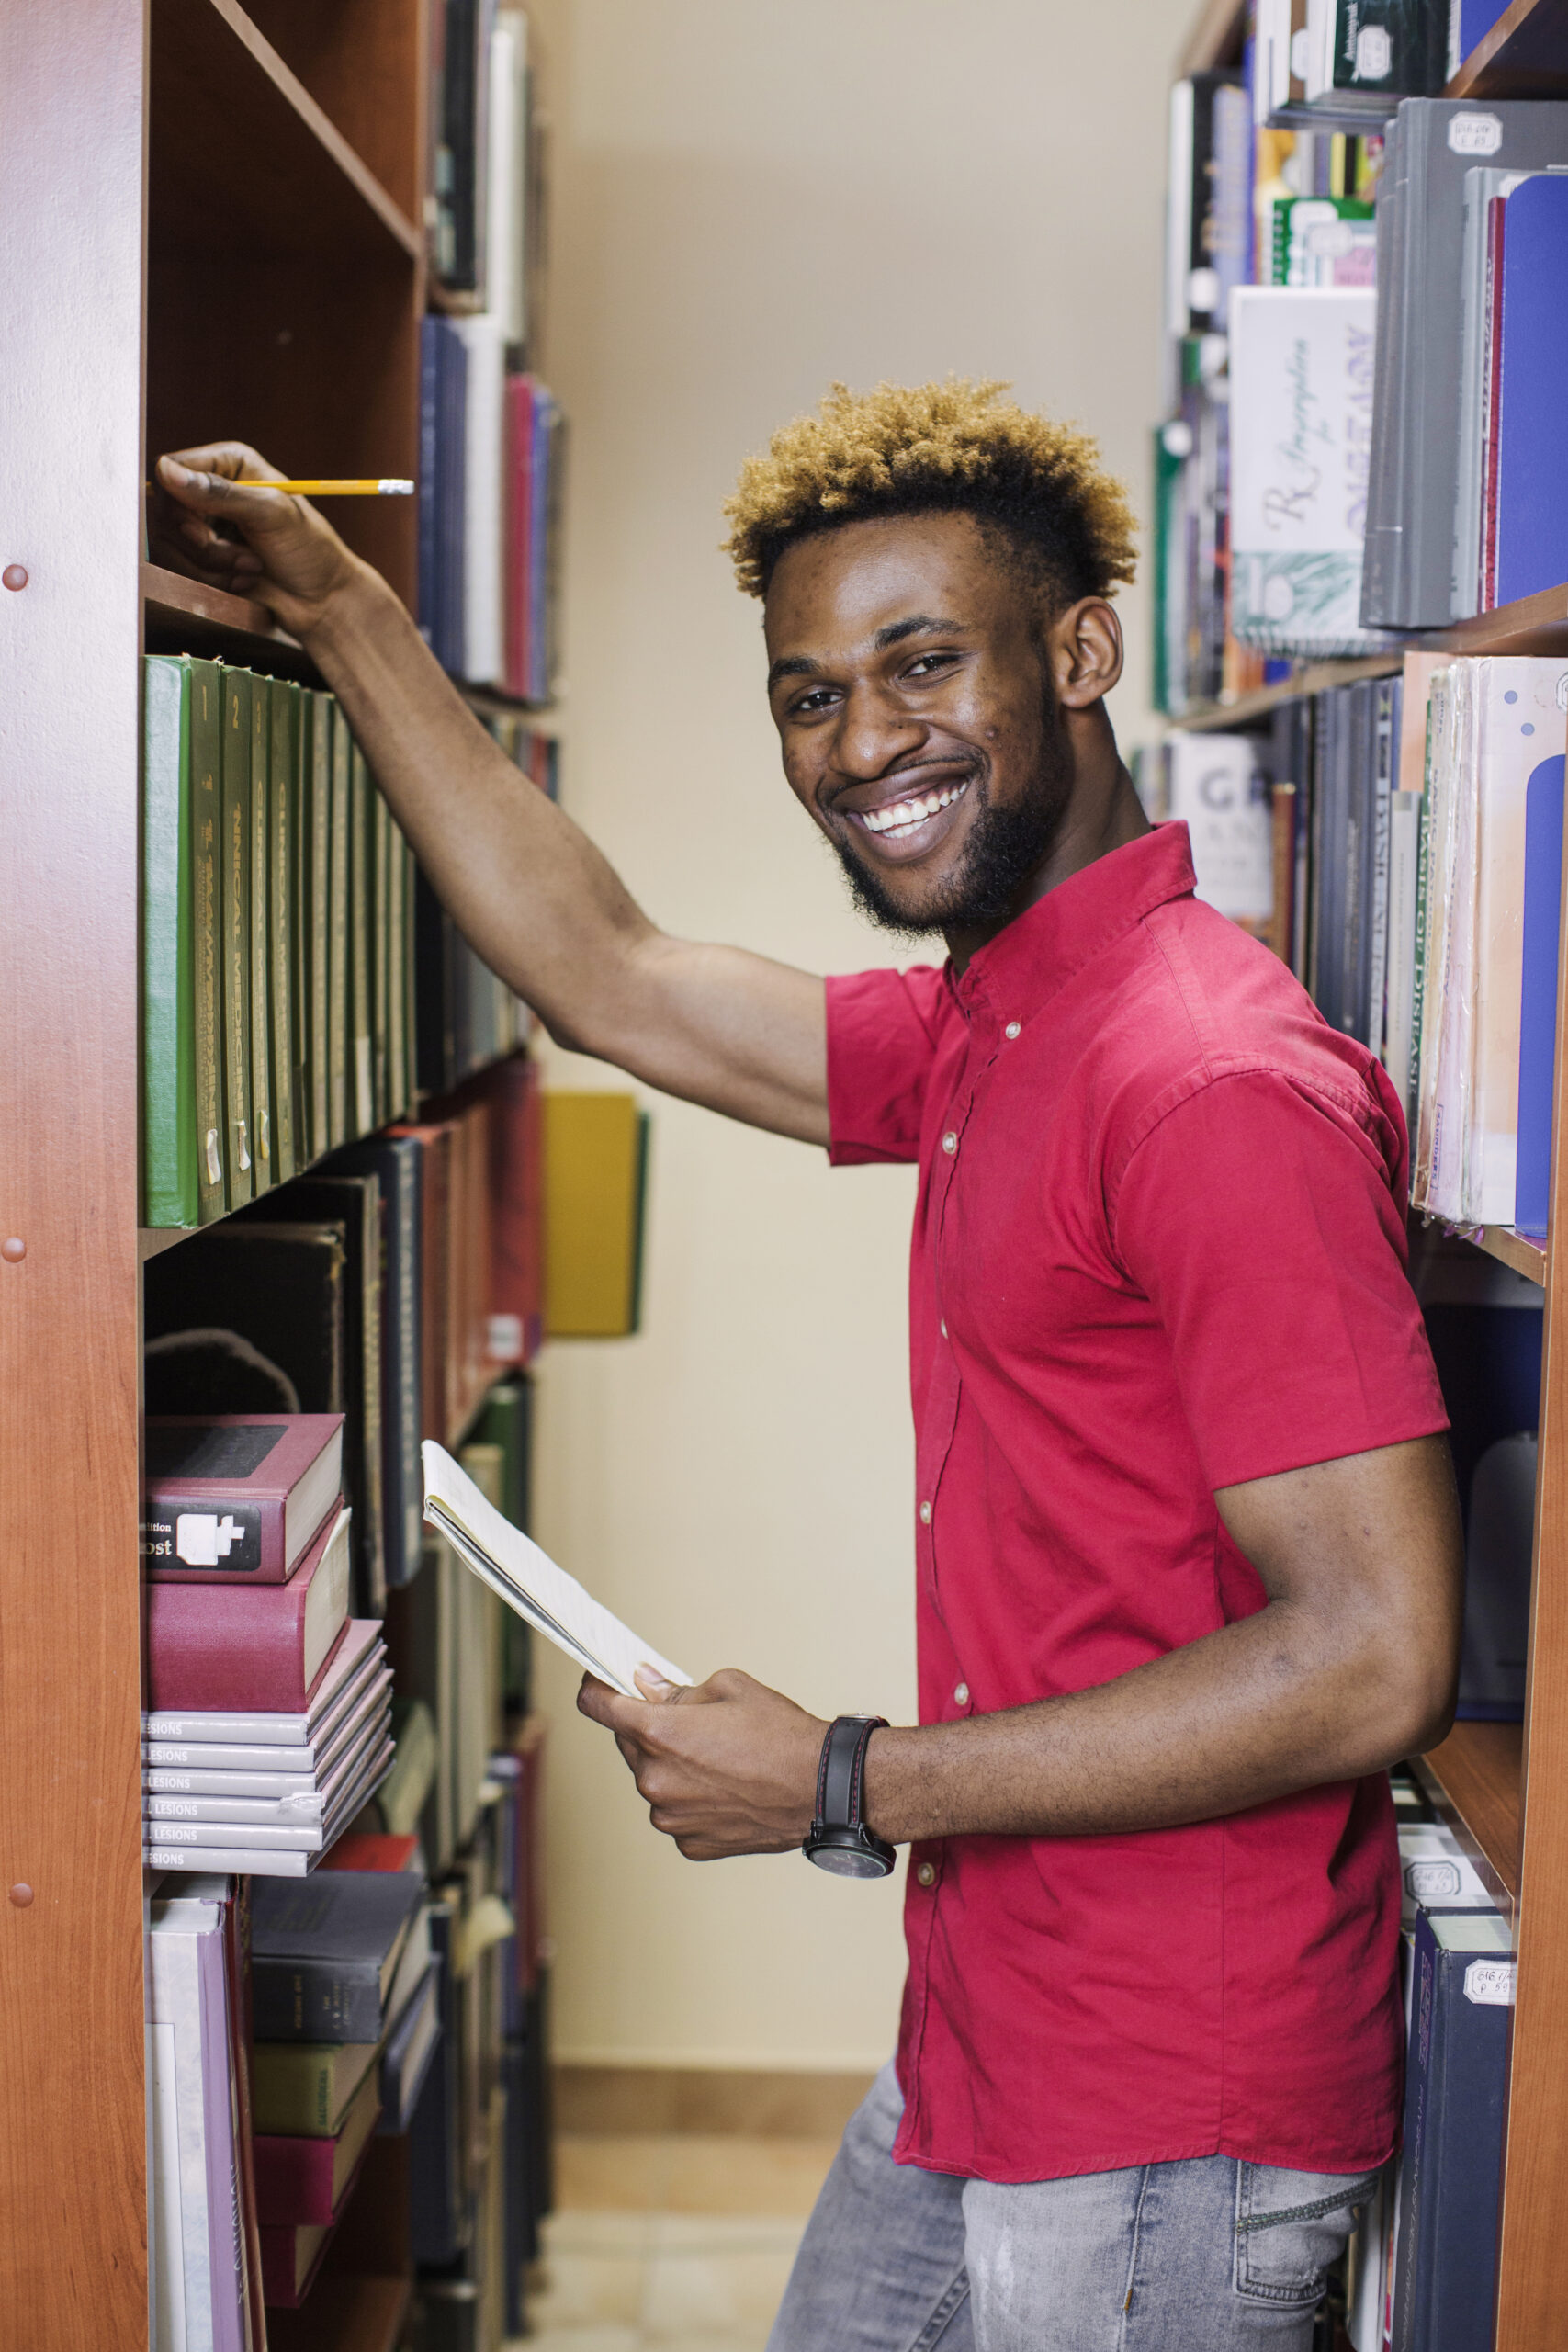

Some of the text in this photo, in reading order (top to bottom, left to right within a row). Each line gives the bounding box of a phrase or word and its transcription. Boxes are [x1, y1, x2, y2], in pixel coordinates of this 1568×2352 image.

[232, 695, 240, 729] 2
[278, 783, 287, 933] CLINICAL
[1408, 962, 1423, 1095] DISEASE
[149, 1777, 191, 1789] LESIONS
[154, 1804, 198, 1815] LESIONS
[154, 1829, 197, 1840] LESIONS
